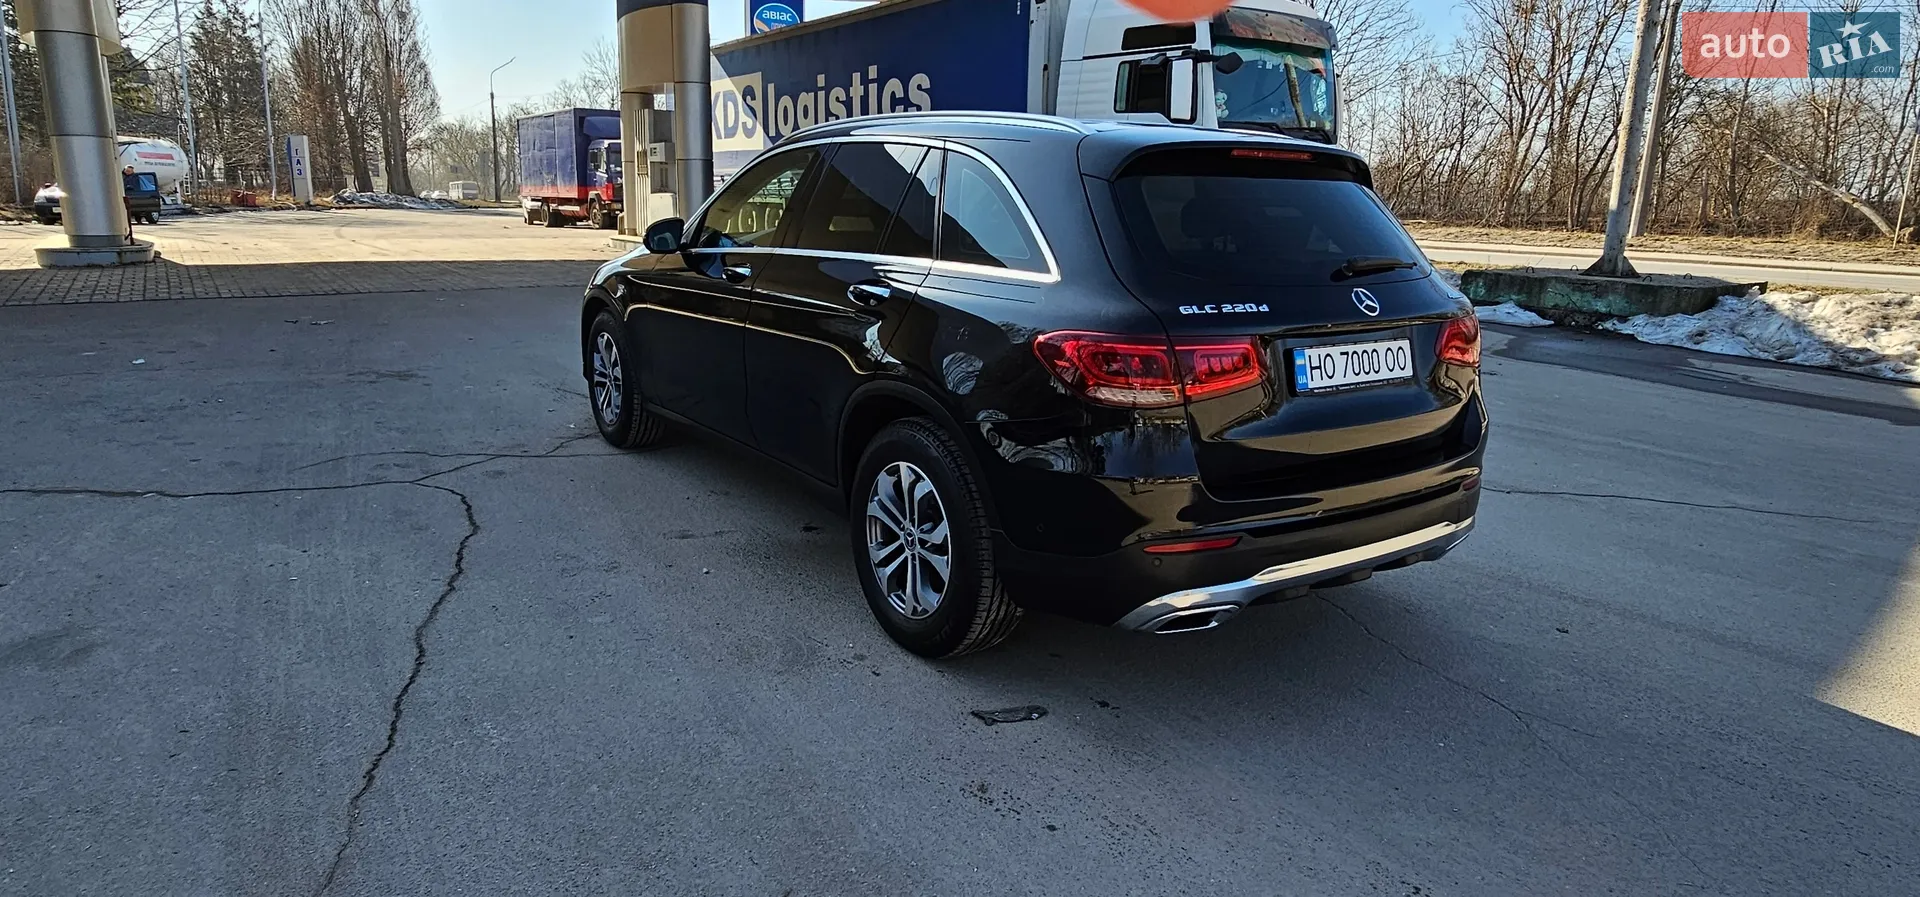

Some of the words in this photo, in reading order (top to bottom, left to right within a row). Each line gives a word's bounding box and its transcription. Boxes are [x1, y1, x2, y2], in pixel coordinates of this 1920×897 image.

[767, 64, 931, 136] logistics
[1179, 305, 1218, 315] GLC
[1308, 353, 1336, 382] HO
[1340, 348, 1381, 379] 7000
[1298, 375, 1307, 384] UA
